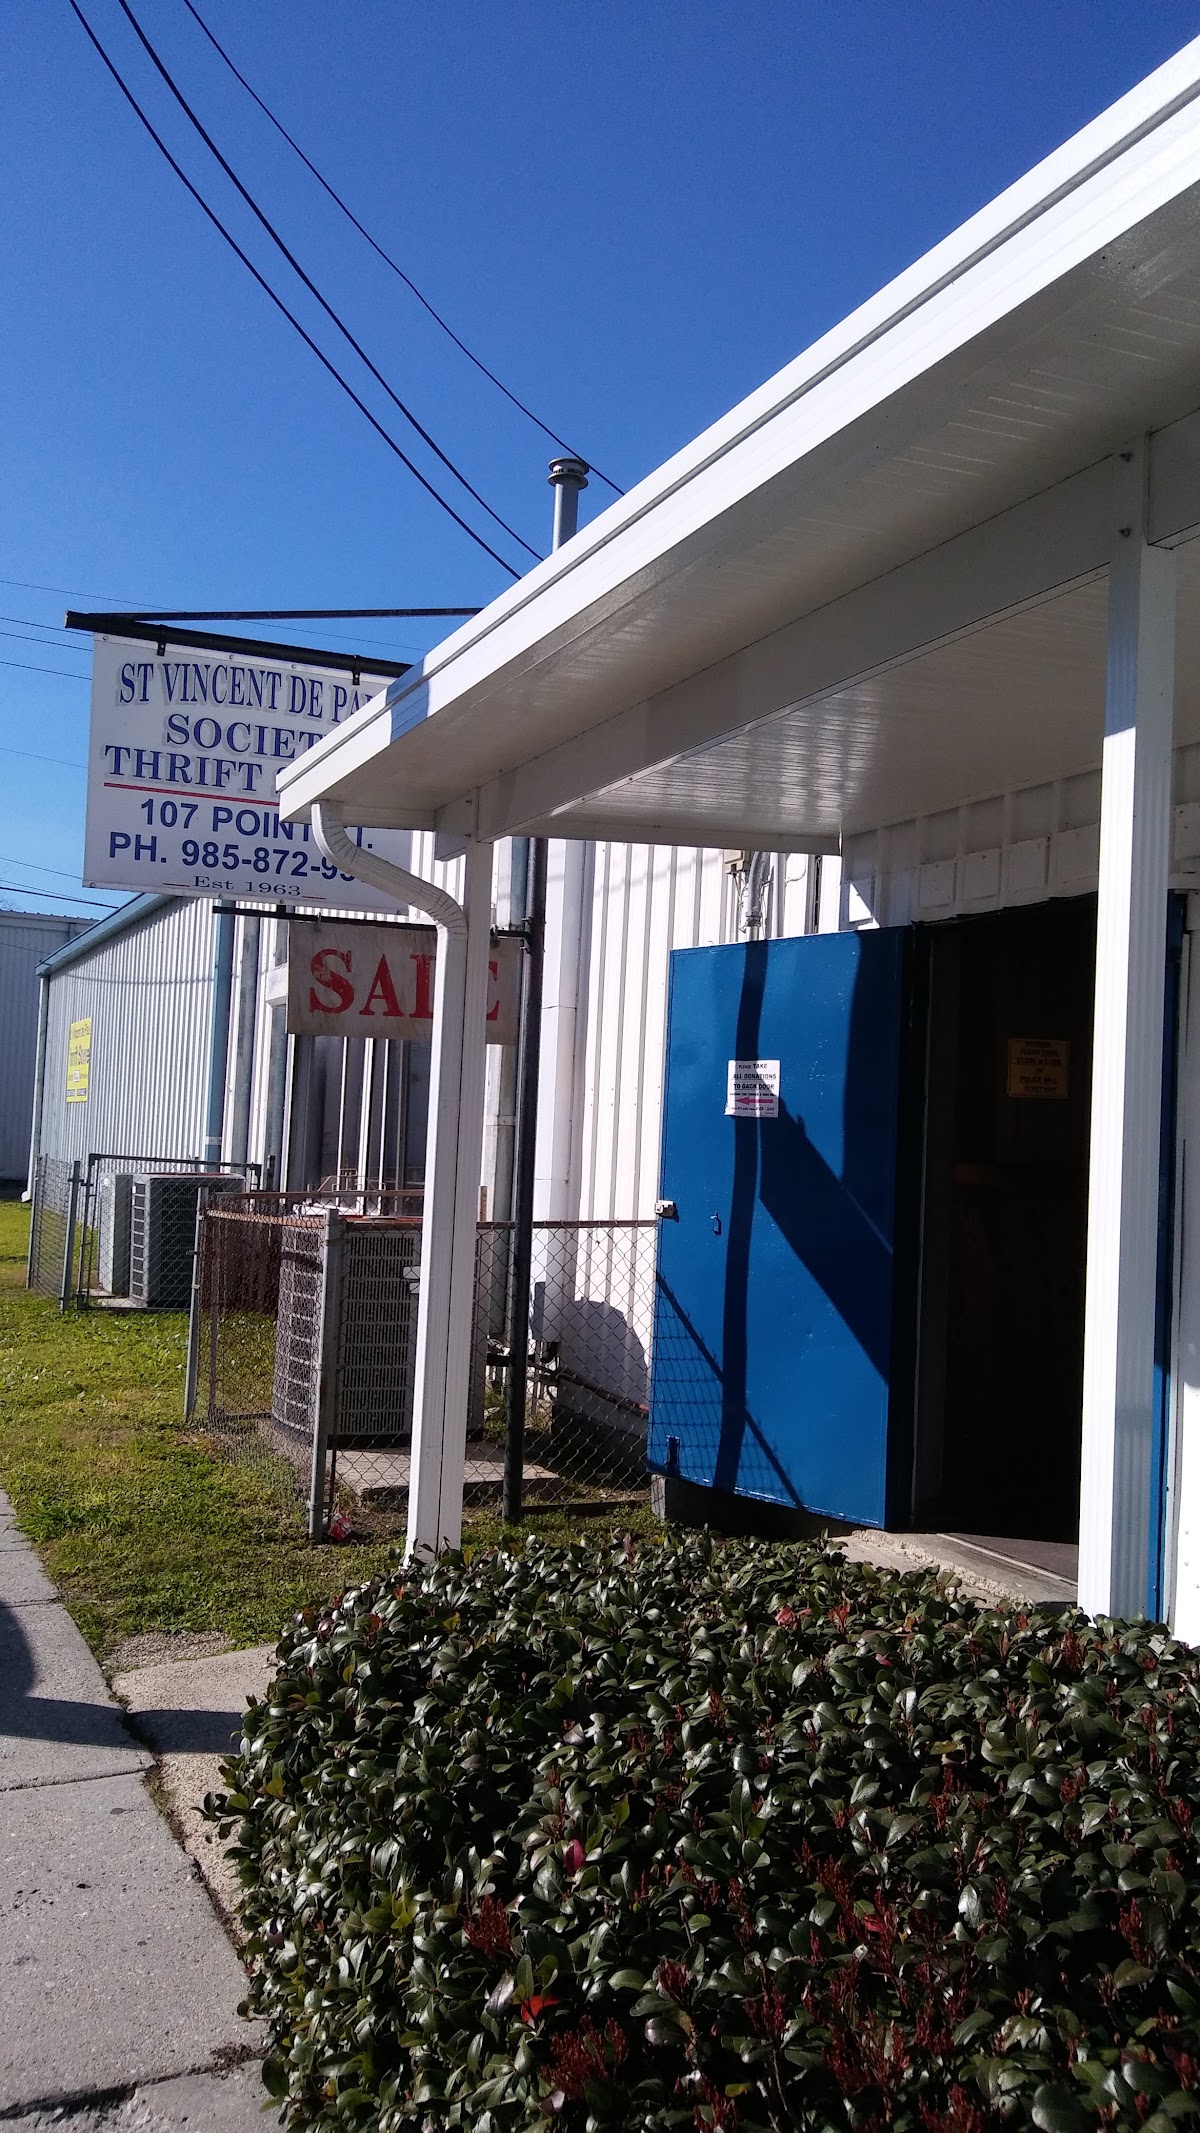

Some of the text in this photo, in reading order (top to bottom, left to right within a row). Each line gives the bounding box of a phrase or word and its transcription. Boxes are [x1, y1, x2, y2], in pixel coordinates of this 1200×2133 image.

[119, 663, 374, 724] ST VINCENT DE PA
[166, 713, 327, 759] SOCIET
[104, 744, 263, 792] THRIFT
[140, 798, 199, 829] 107
[109, 831, 362, 882] PH. 985-872-9
[193, 875, 301, 897] Est 1963
[309, 948, 500, 1021] SAL
